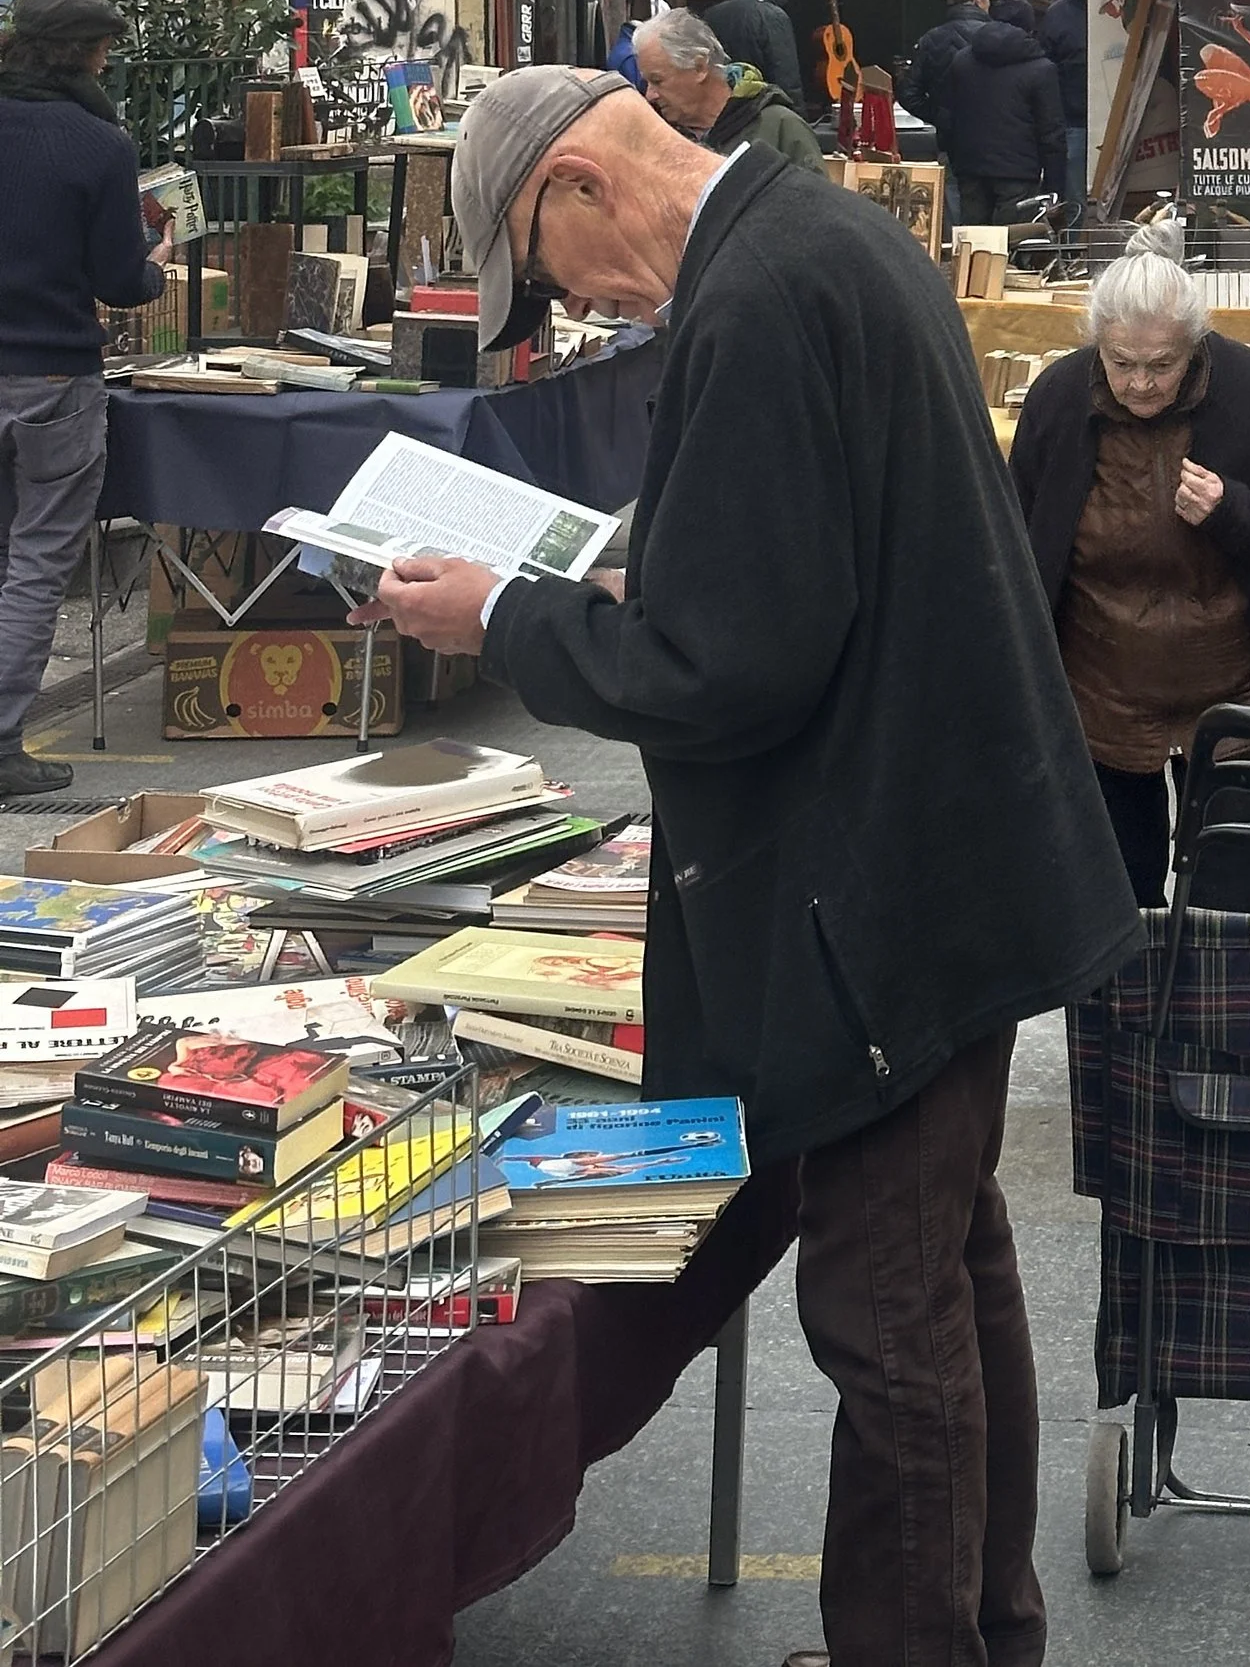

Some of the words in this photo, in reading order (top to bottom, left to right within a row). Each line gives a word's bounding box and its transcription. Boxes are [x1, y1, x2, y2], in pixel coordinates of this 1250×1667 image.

[1193, 174, 1221, 185] TUTTE
[1225, 174, 1234, 185] LE
[179, 178, 194, 206] Harry
[1193, 185, 1202, 196] LE
[184, 203, 199, 233] Potter
[248, 700, 314, 720] simba
[390, 1071, 447, 1085] STAMPA
[665, 1115, 726, 1126] Panini
